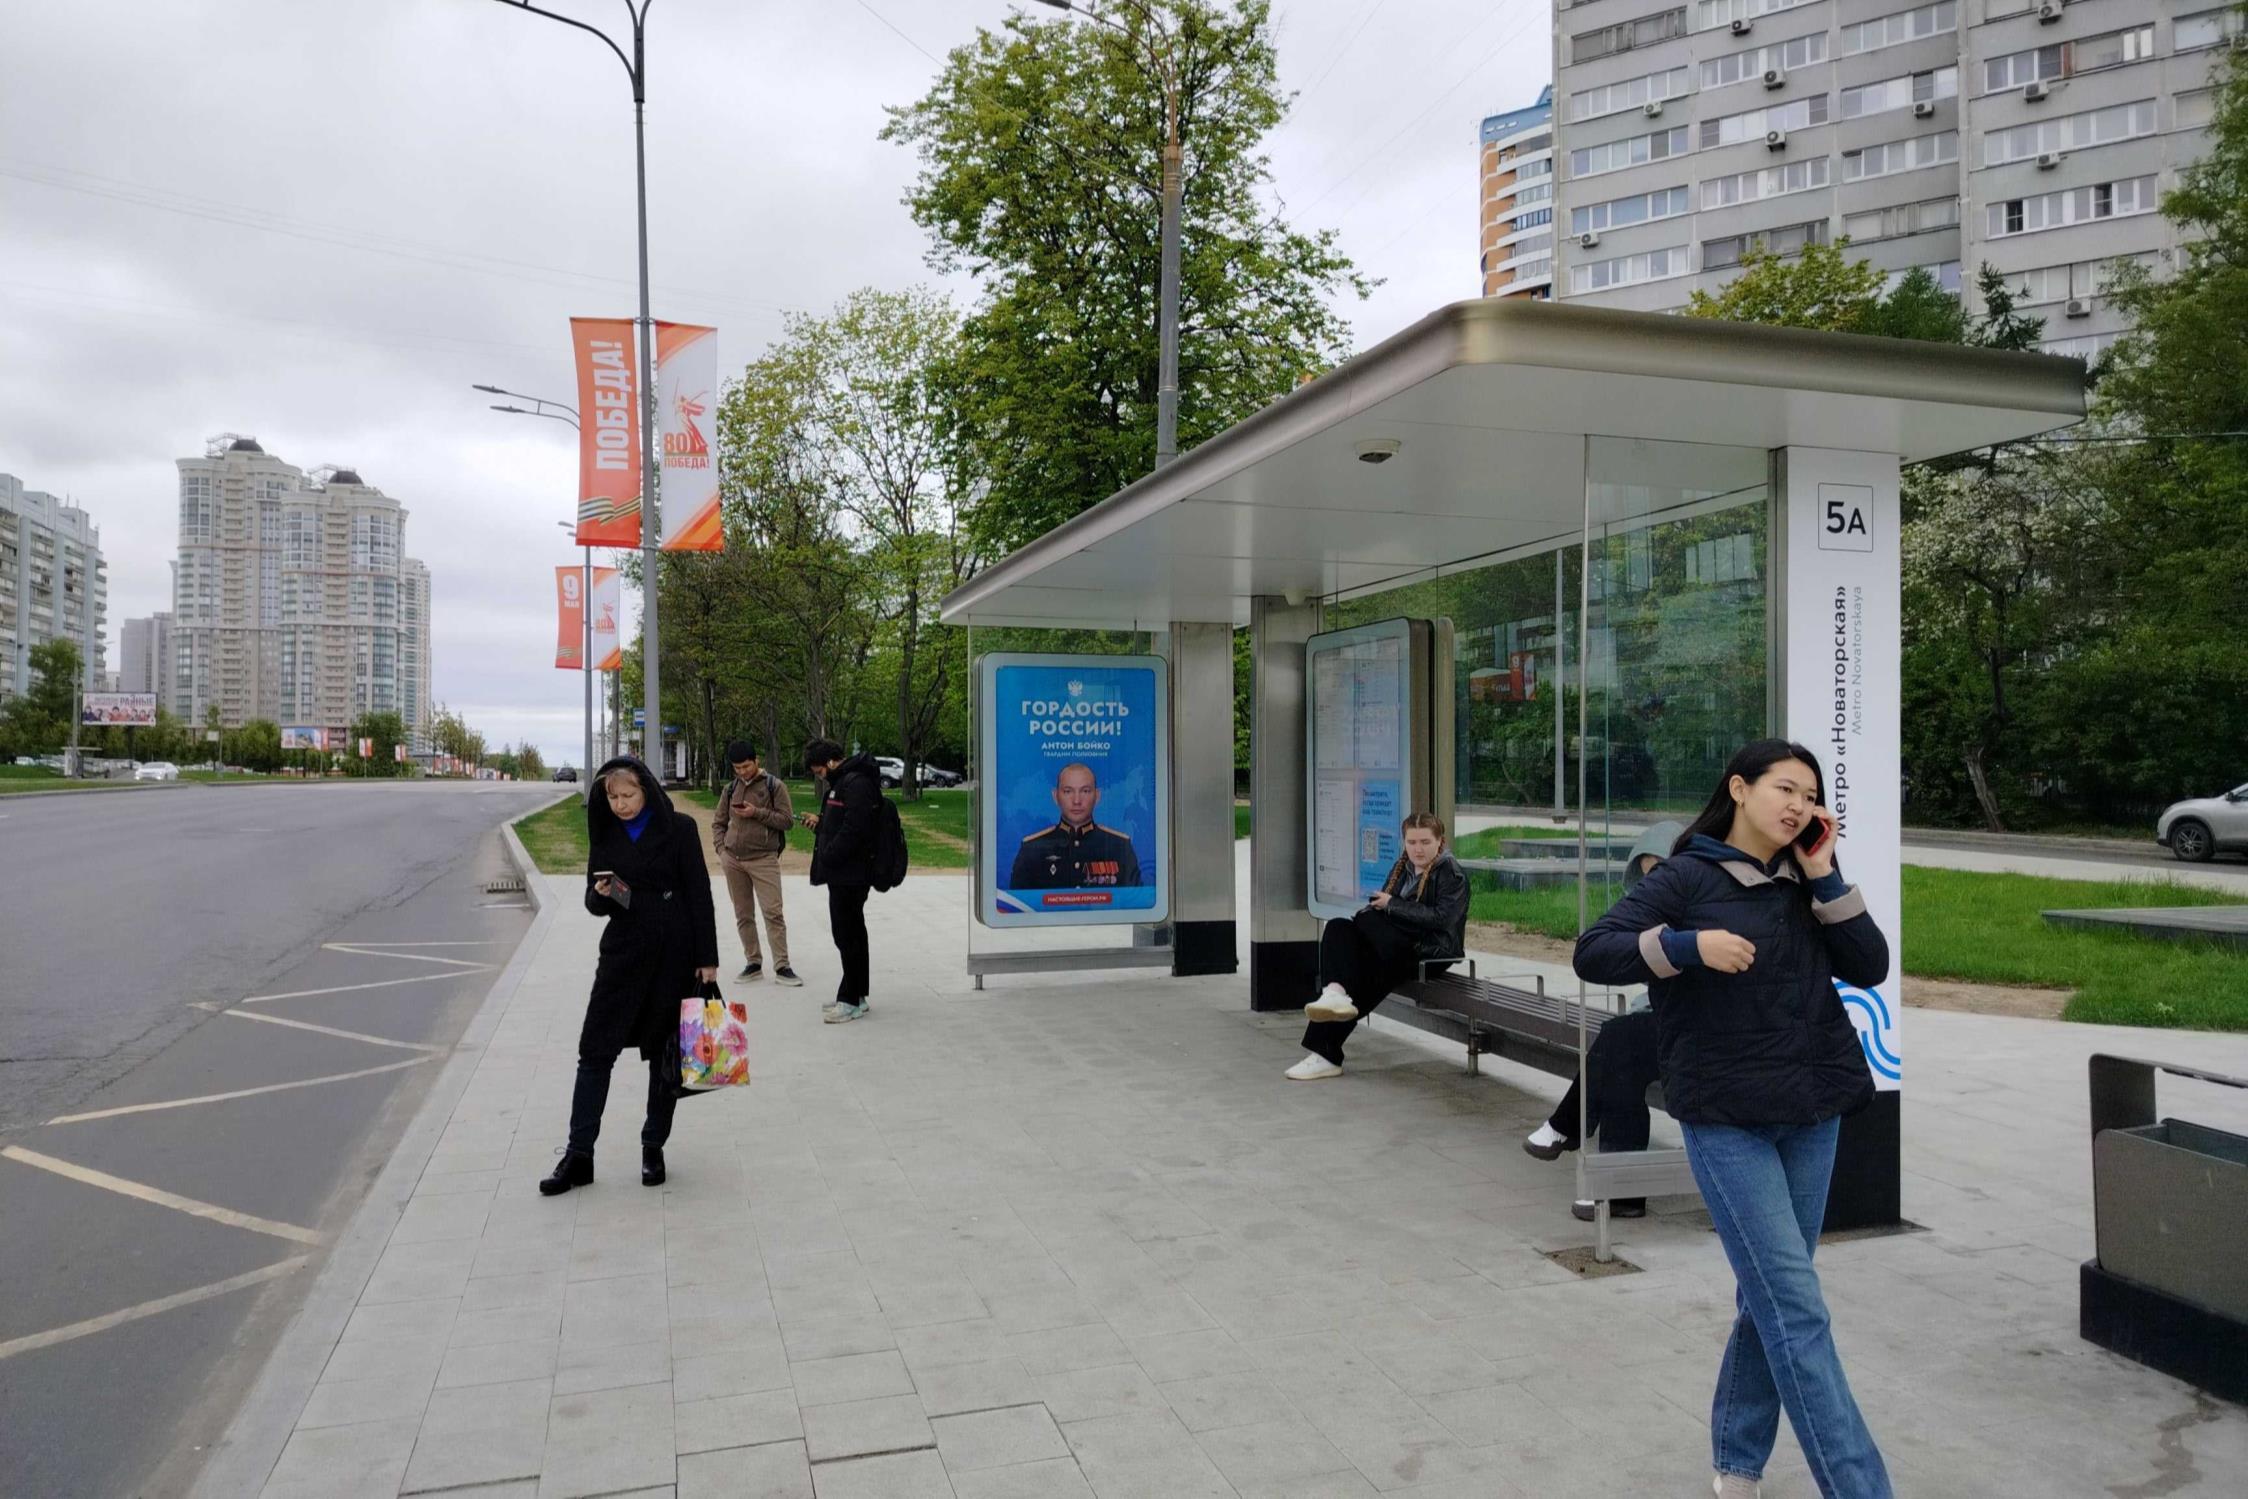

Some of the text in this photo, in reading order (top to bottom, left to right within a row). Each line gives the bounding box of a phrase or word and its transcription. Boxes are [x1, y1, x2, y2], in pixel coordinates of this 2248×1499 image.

[590, 339, 632, 470] ПОБЕДА!
[663, 432, 691, 453] 80
[663, 456, 710, 468] ПОБЕДА!
[1826, 501, 1866, 535] 5А
[562, 575, 579, 600] 9
[1831, 586, 1849, 756] «Новаторская»
[1852, 586, 1864, 736] Metro Novatorskaya
[1021, 700, 1129, 718] ГОРДОСТЬ
[1029, 720, 1122, 736] РОССИИ!
[1041, 739, 1111, 750] АНТОН БОЙКО
